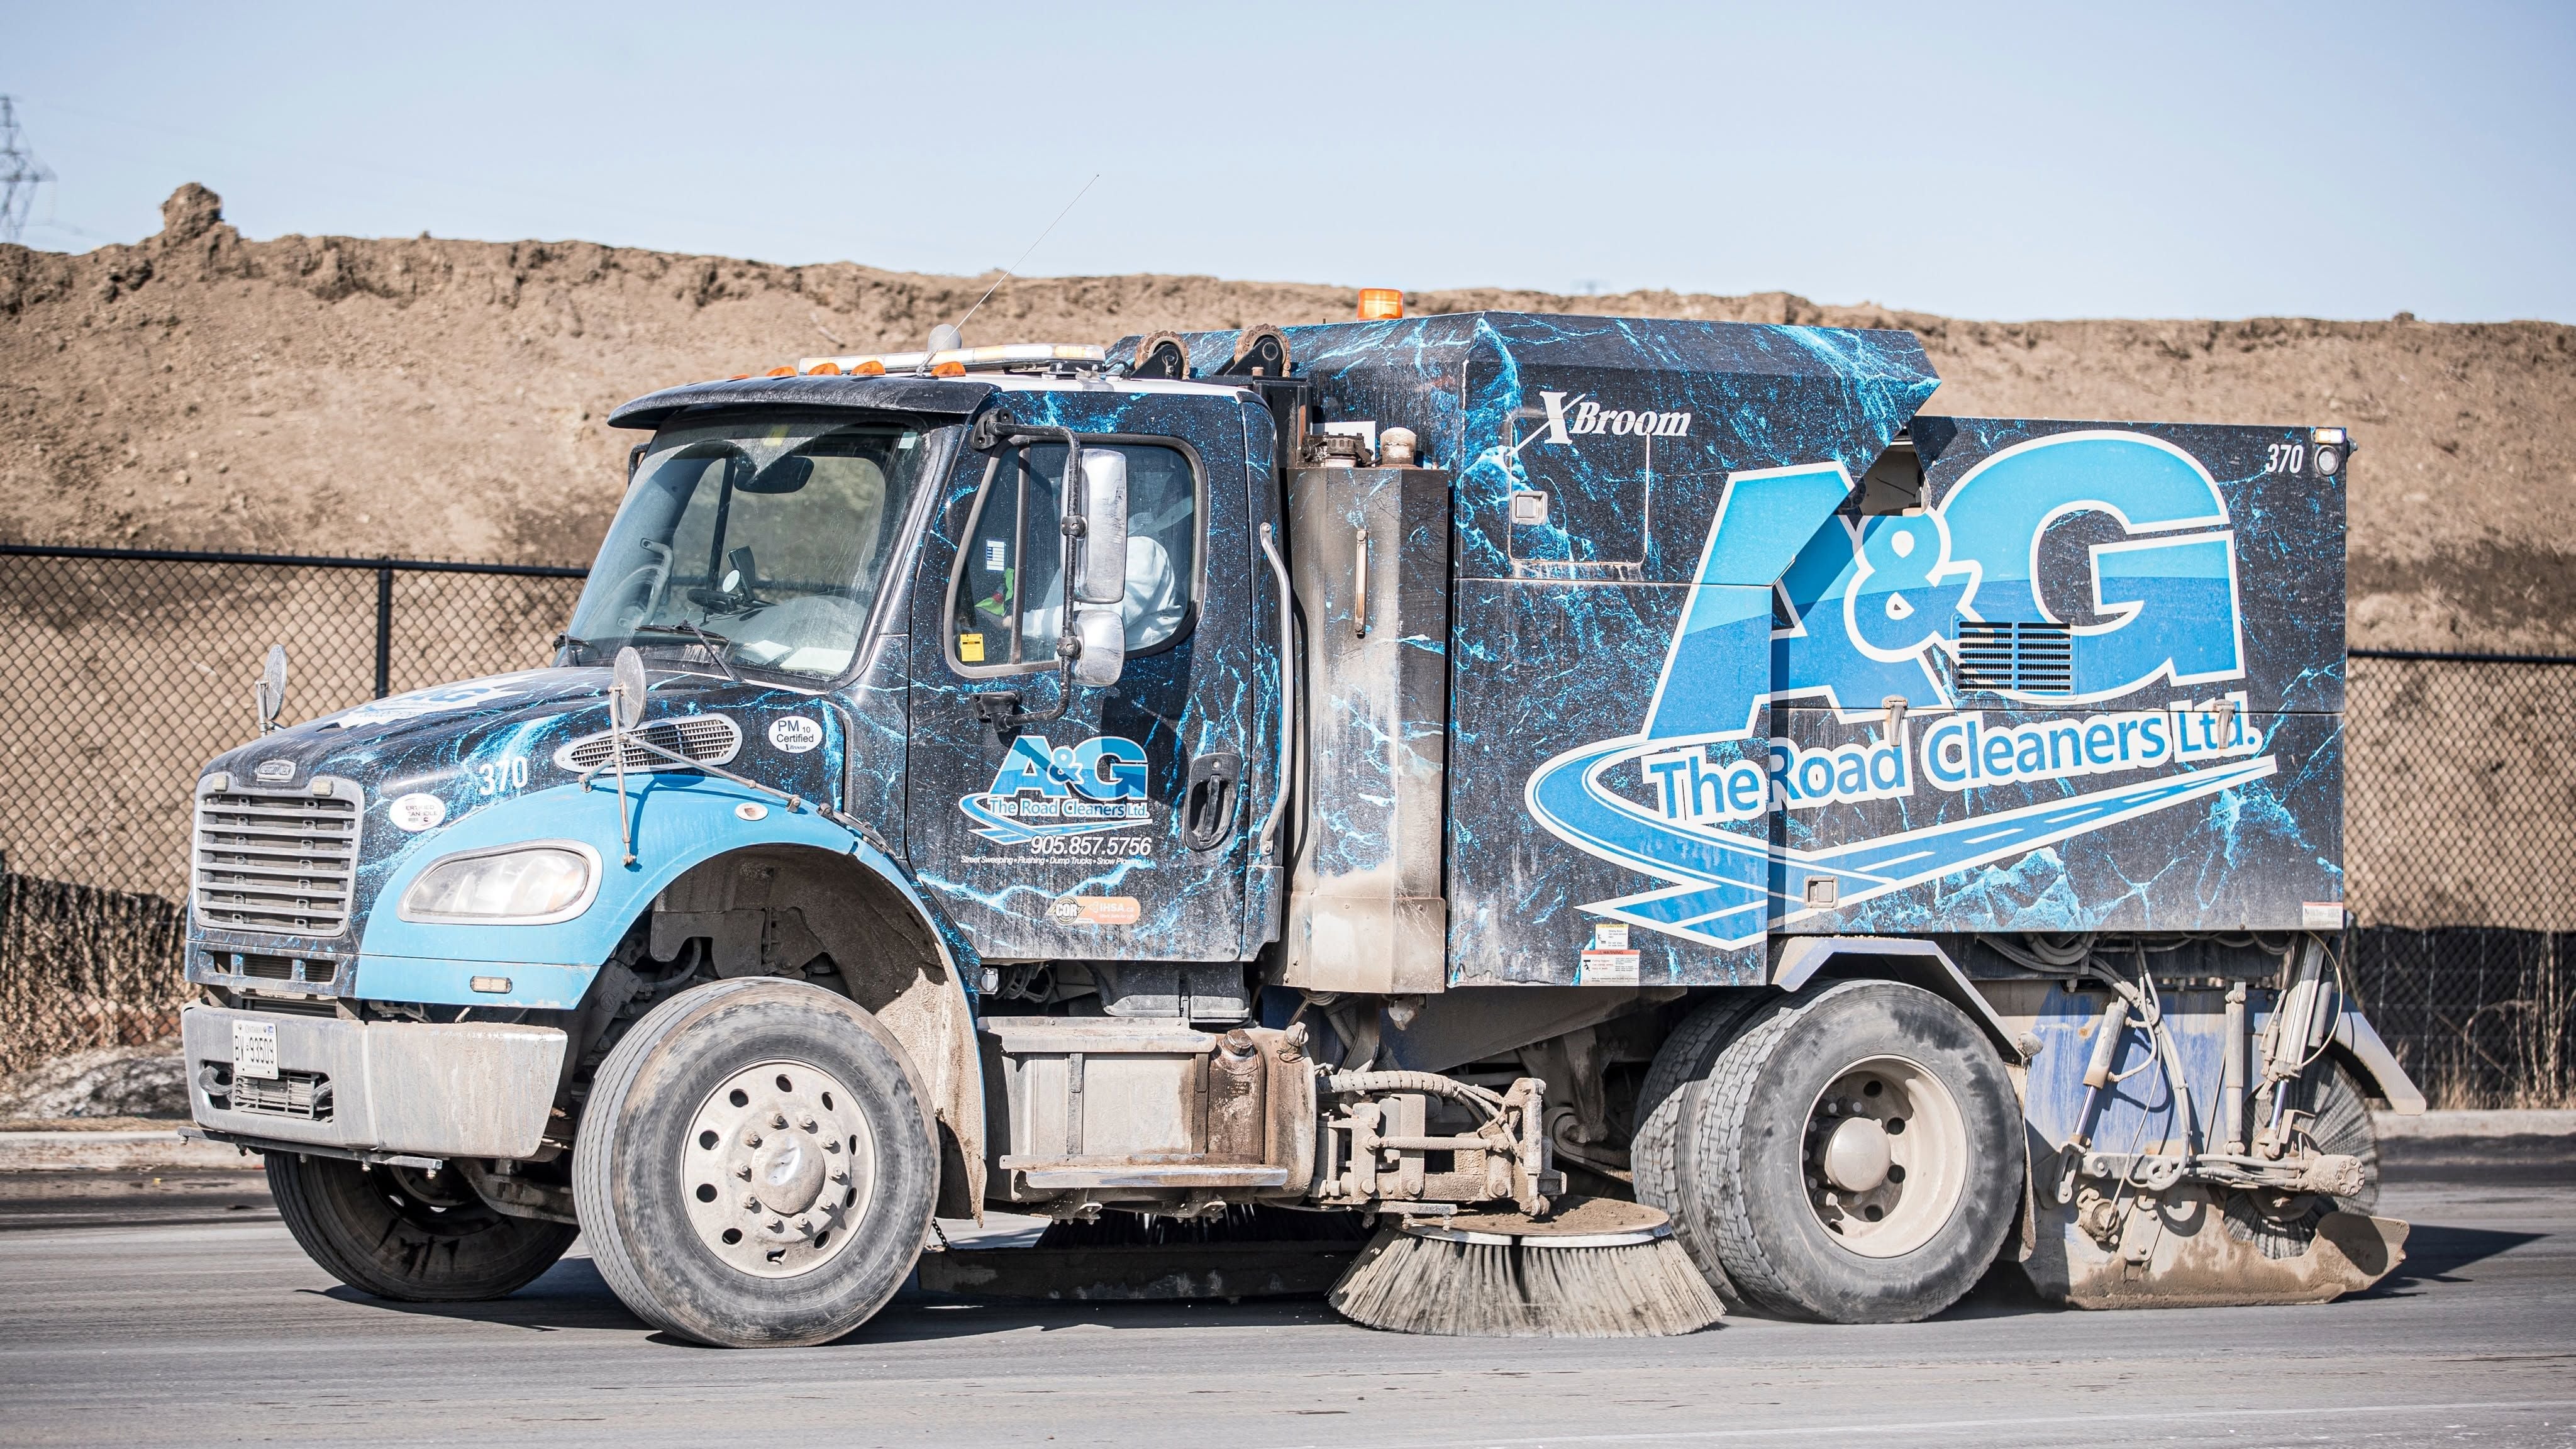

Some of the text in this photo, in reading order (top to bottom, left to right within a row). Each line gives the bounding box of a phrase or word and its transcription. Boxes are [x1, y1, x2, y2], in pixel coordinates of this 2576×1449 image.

[2265, 443, 2304, 474] 370
[1642, 430, 2245, 740] A&G
[776, 733, 814, 743] Certified
[777, 720, 799, 732] PM
[987, 735, 1149, 801] A&G
[1650, 699, 2257, 819] The Road Cleaners Ltd.
[479, 755, 528, 796] 370
[989, 799, 1148, 816] The Road Cleaners Ltd.
[1030, 835, 1153, 856] 905.857.5756
[960, 855, 981, 864] Street
[981, 855, 1013, 865] Sweeping
[1017, 856, 1045, 866] Flushing
[1049, 857, 1070, 867] Dump
[1070, 857, 1092, 865] Trucks
[1096, 857, 1116, 865] Snow
[1055, 903, 1078, 917] COR
[250, 1036, 274, 1064] 93509
